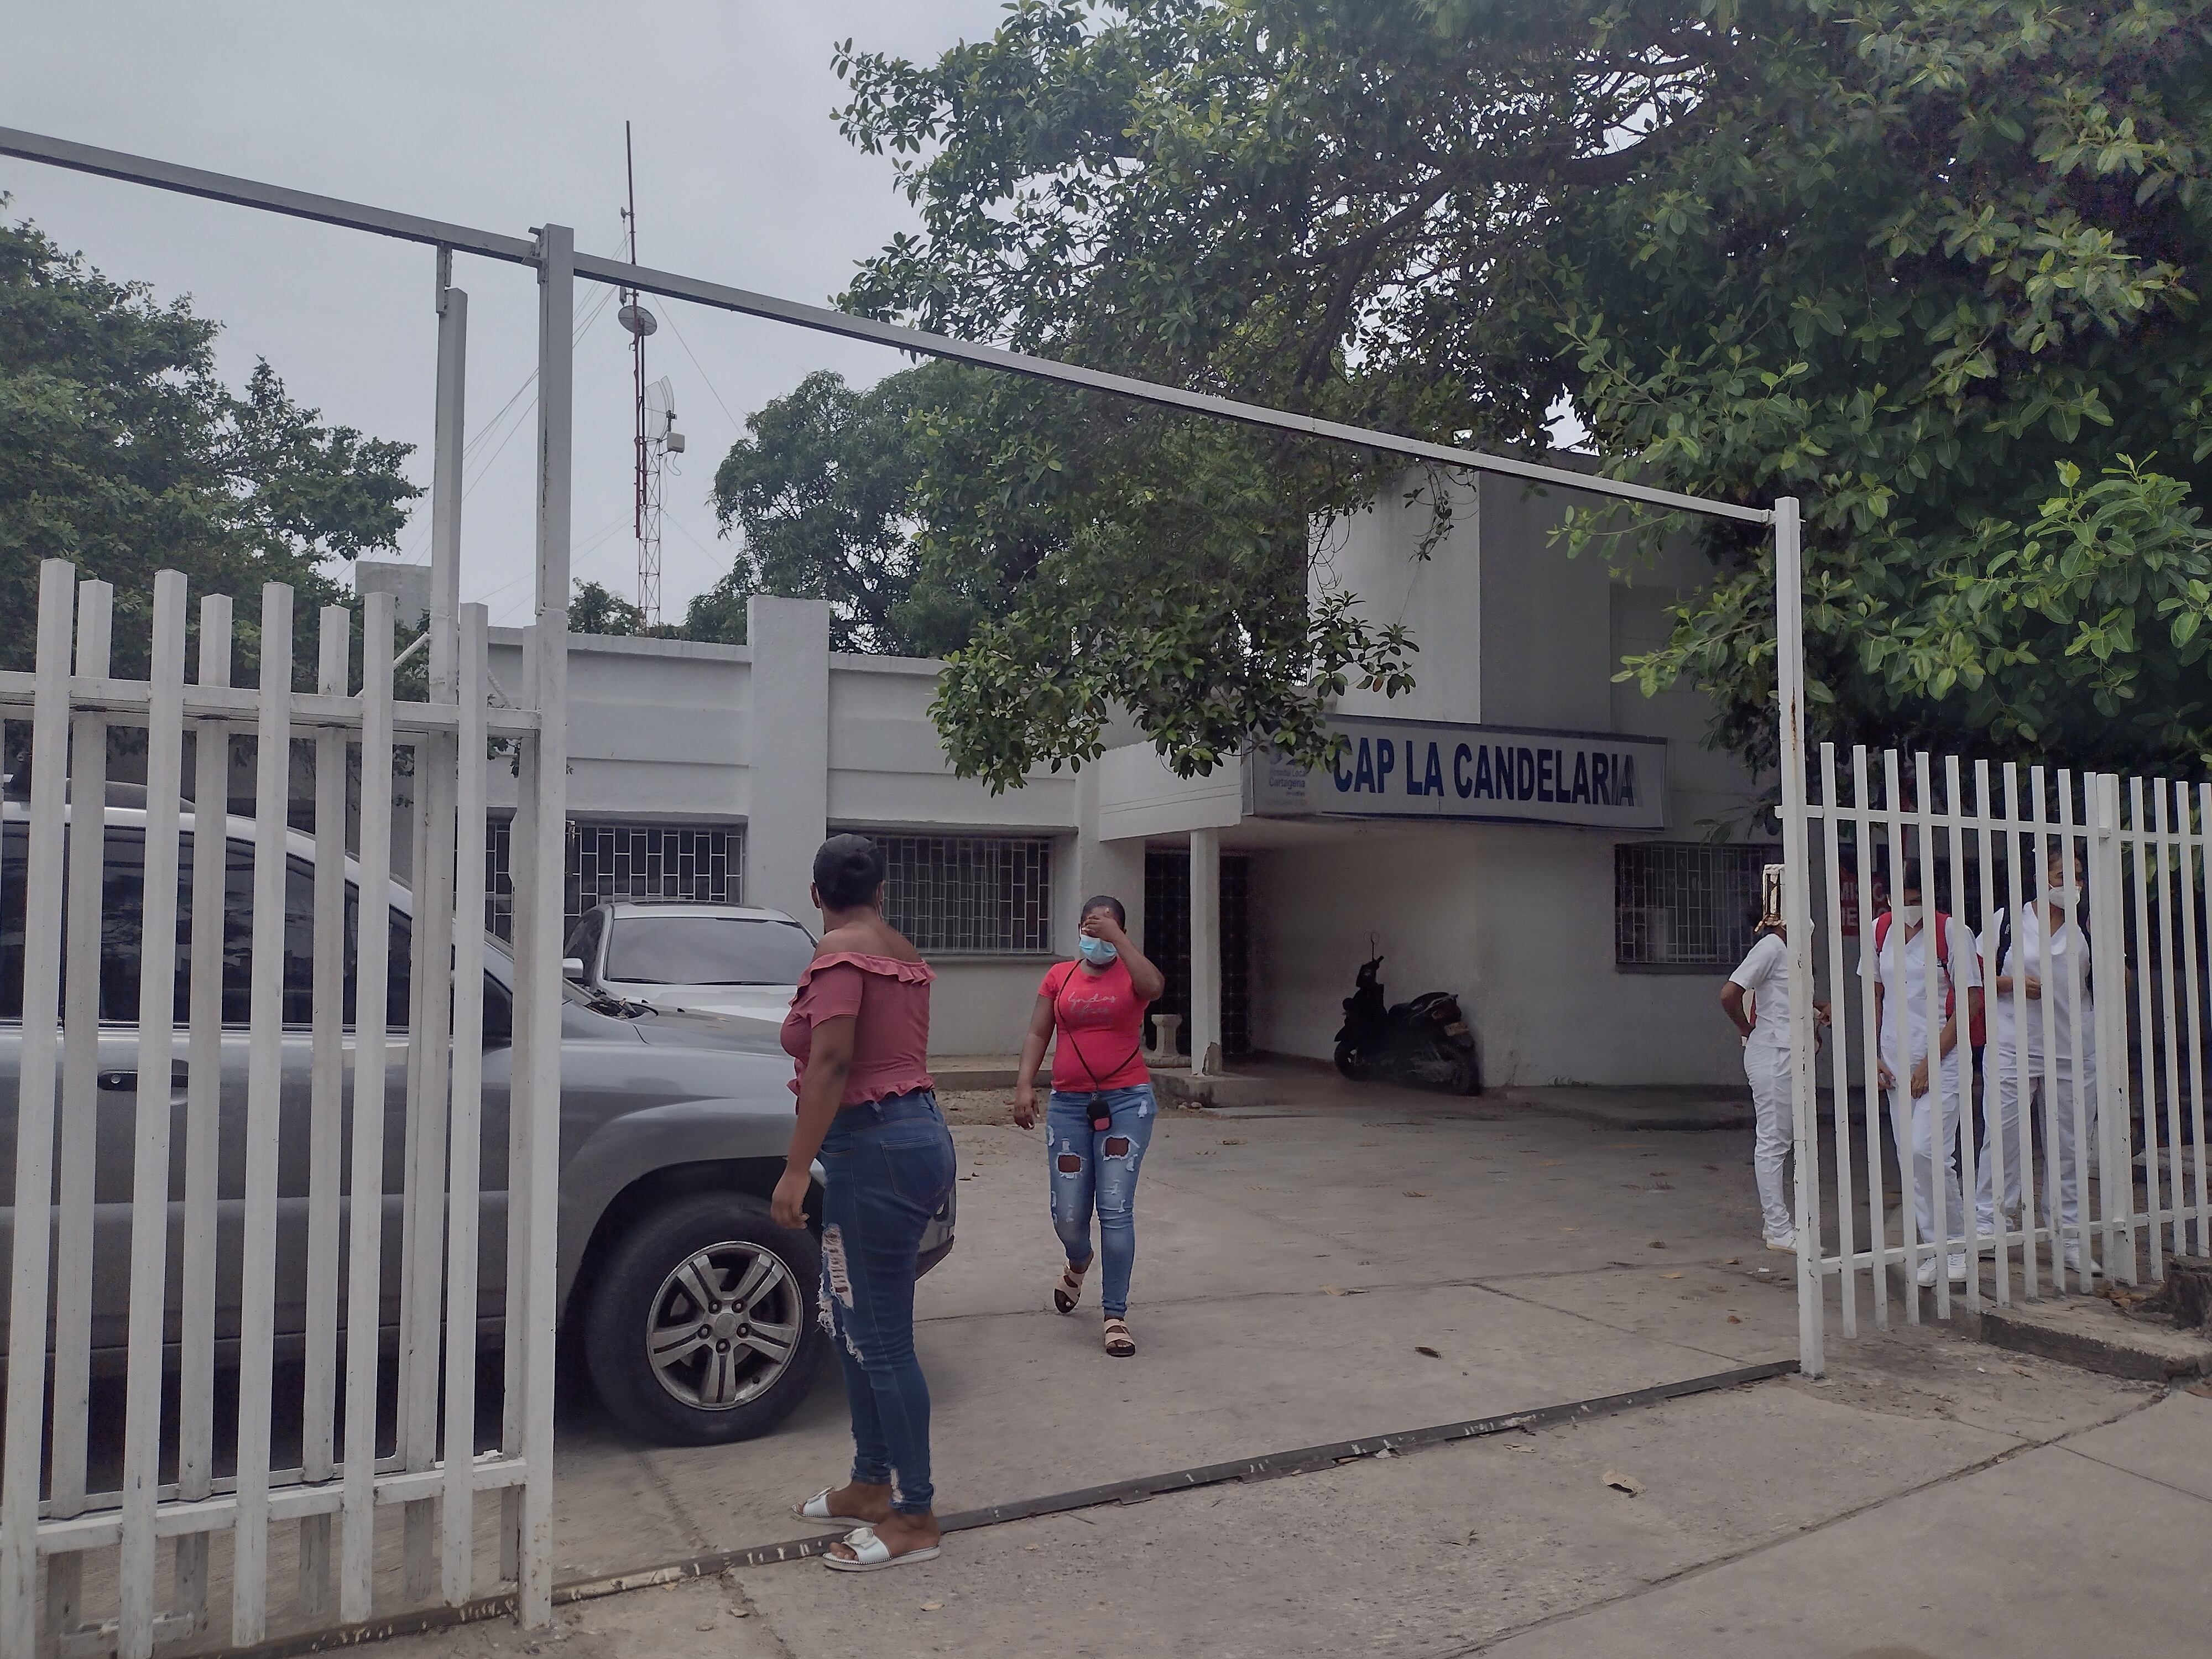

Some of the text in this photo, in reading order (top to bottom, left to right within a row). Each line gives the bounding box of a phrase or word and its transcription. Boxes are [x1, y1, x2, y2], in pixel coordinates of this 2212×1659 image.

[1333, 735, 1636, 807] CAP LA CANDELARIA
